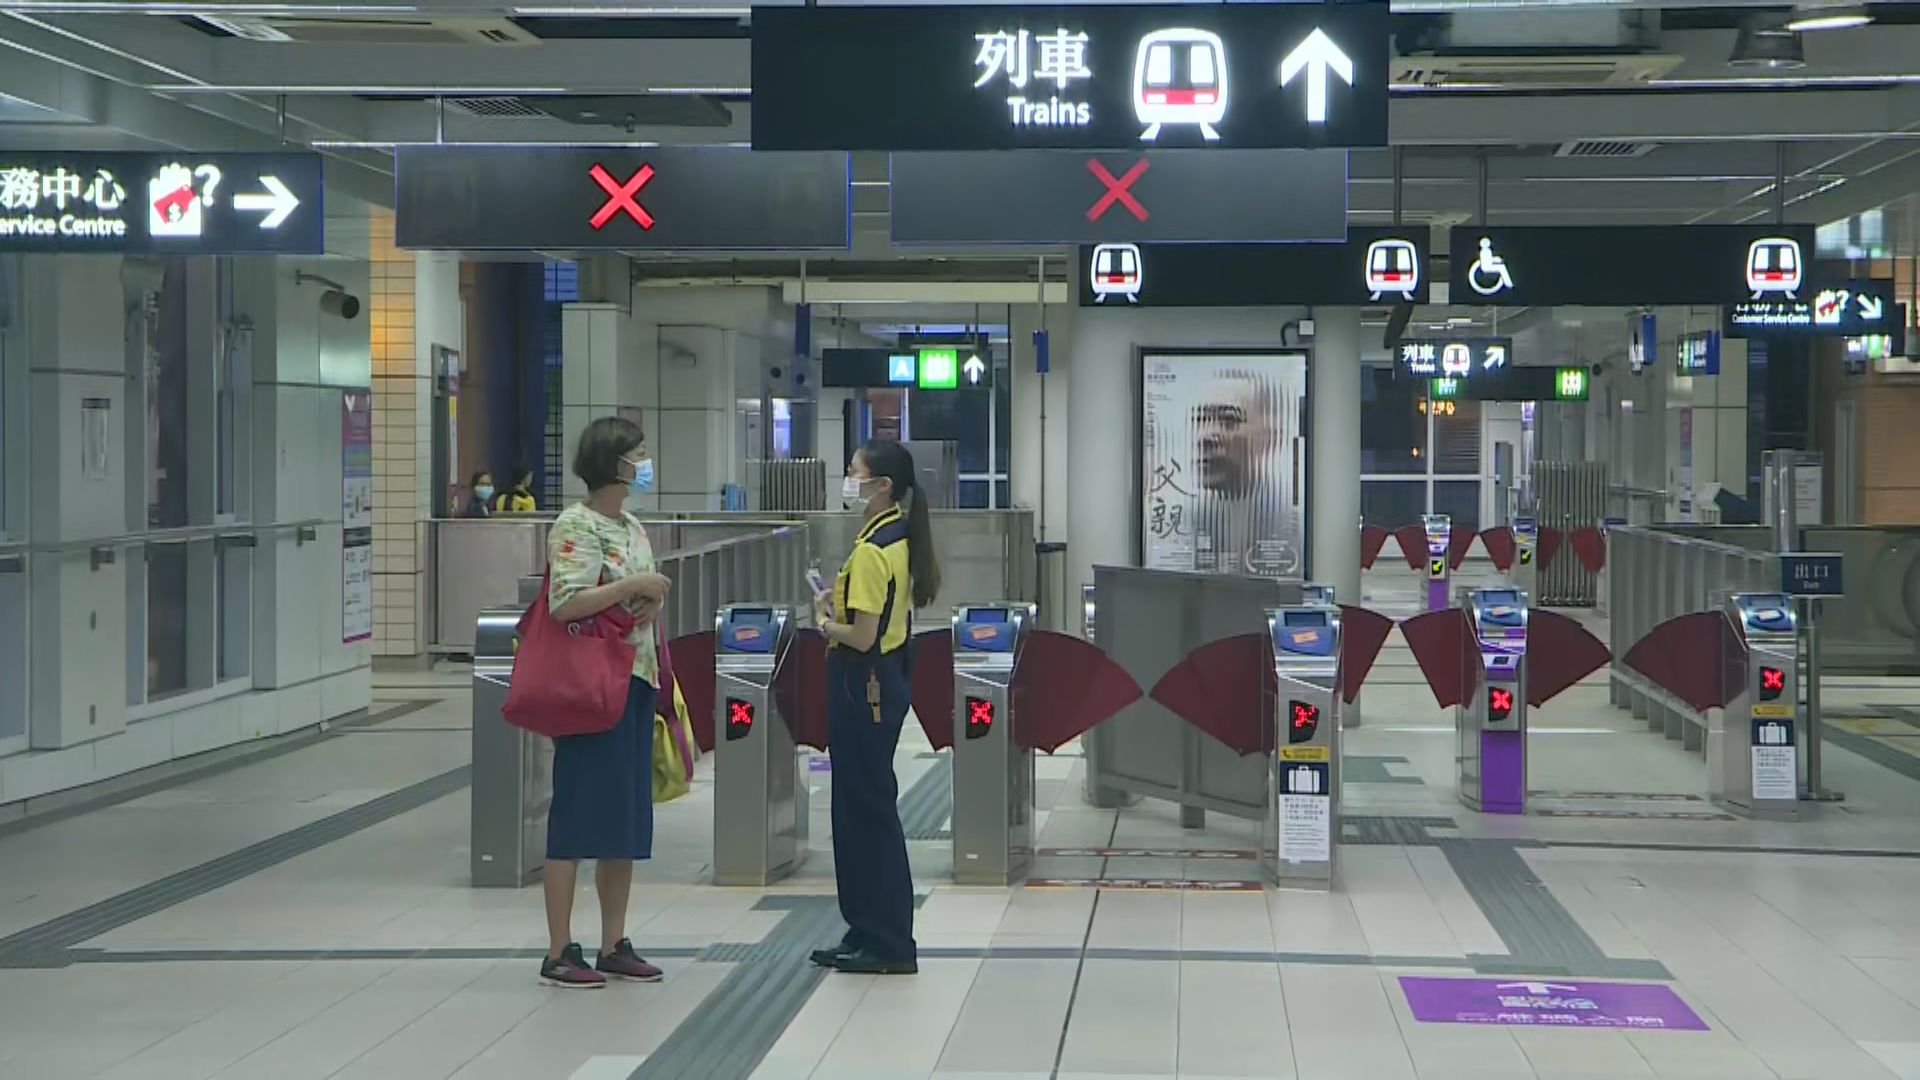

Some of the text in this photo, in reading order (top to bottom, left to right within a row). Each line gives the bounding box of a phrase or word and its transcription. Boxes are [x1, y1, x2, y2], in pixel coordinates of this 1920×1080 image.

[974, 29, 1091, 88] 列車
[1007, 96, 1090, 126] Trains
[0, 167, 126, 209] 務中心
[59, 214, 126, 236] Centre
[895, 358, 910, 377] A
[1401, 343, 1434, 362] 列車
[1149, 457, 1198, 540] 父親
